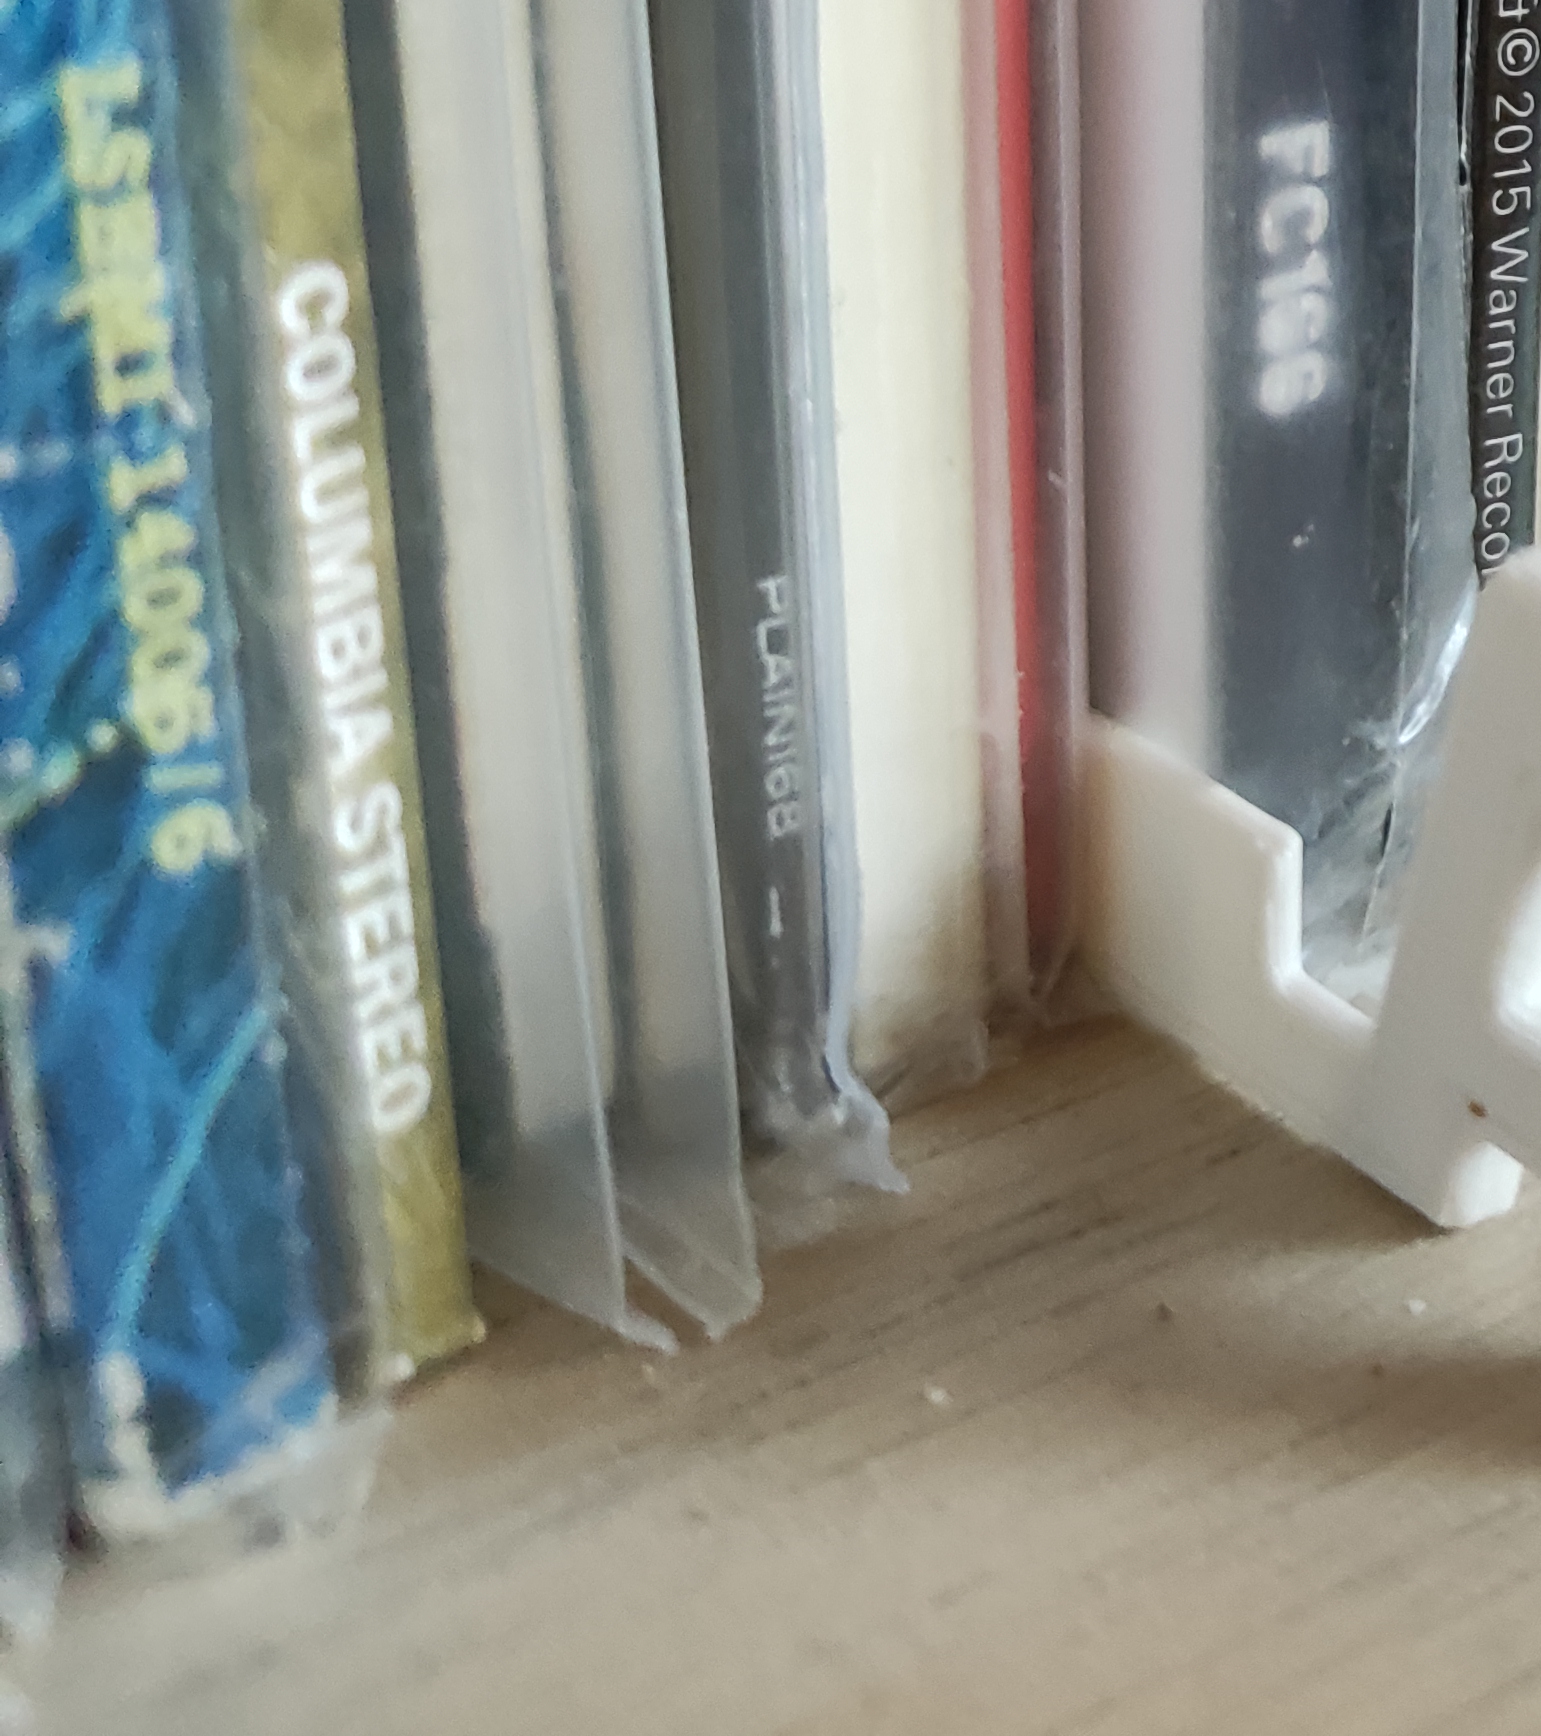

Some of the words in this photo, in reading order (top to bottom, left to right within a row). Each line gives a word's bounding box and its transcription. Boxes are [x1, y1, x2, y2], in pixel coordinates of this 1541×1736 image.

[1491, 90, 1536, 217] 2015
[1485, 222, 1530, 418] Warner
[276, 261, 390, 764] COLUMBIA
[332, 780, 432, 1133] STEREO
